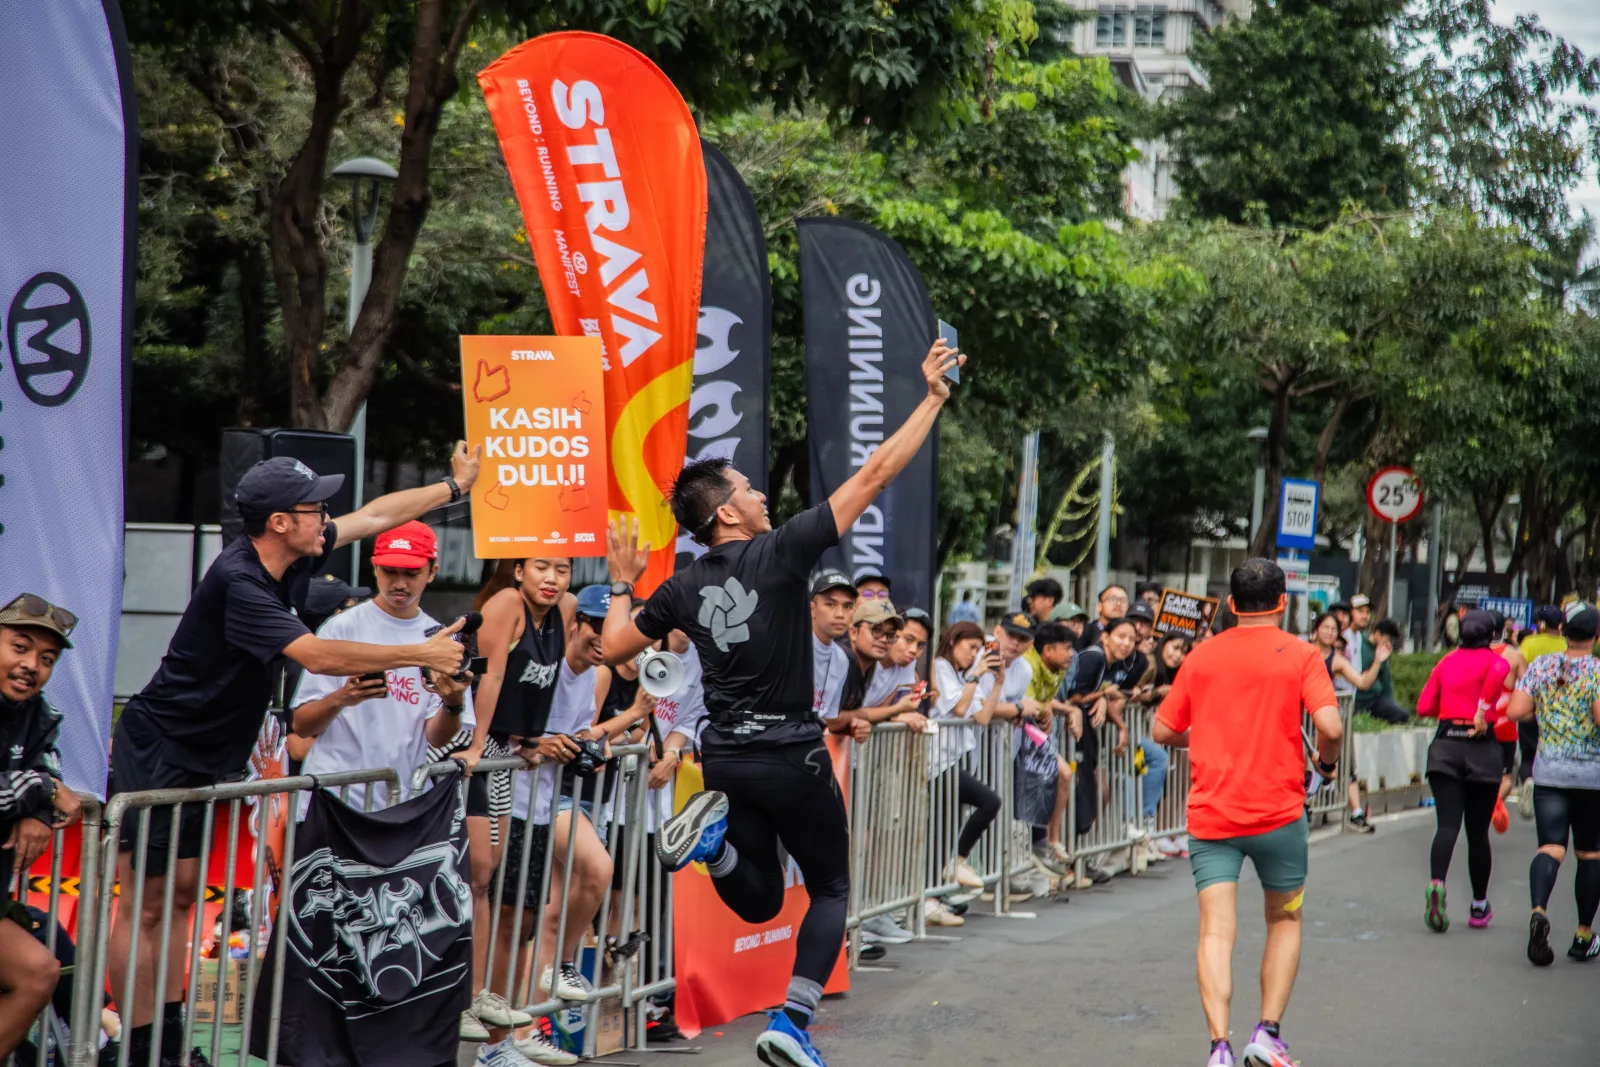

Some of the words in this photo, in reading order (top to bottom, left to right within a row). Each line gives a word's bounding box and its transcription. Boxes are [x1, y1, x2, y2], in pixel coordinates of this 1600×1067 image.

[516, 79, 542, 135] BEYOND
[537, 147, 562, 212] RUNNING
[551, 78, 664, 369] STRAVA
[553, 229, 581, 298] MANIFEST
[511, 350, 556, 361] STRAVA
[489, 407, 582, 430] KASIH
[485, 435, 590, 458] KUDOS
[497, 463, 586, 487] DULU!
[1379, 484, 1404, 507] 25
[1287, 511, 1310, 529] STOP
[1165, 594, 1199, 611] CAPEK
[1160, 612, 1196, 630] STRAVA
[386, 671, 416, 691] OME
[388, 685, 420, 705] MING
[734, 933, 760, 953] BEYOND
[765, 925, 792, 945] RUNNING
